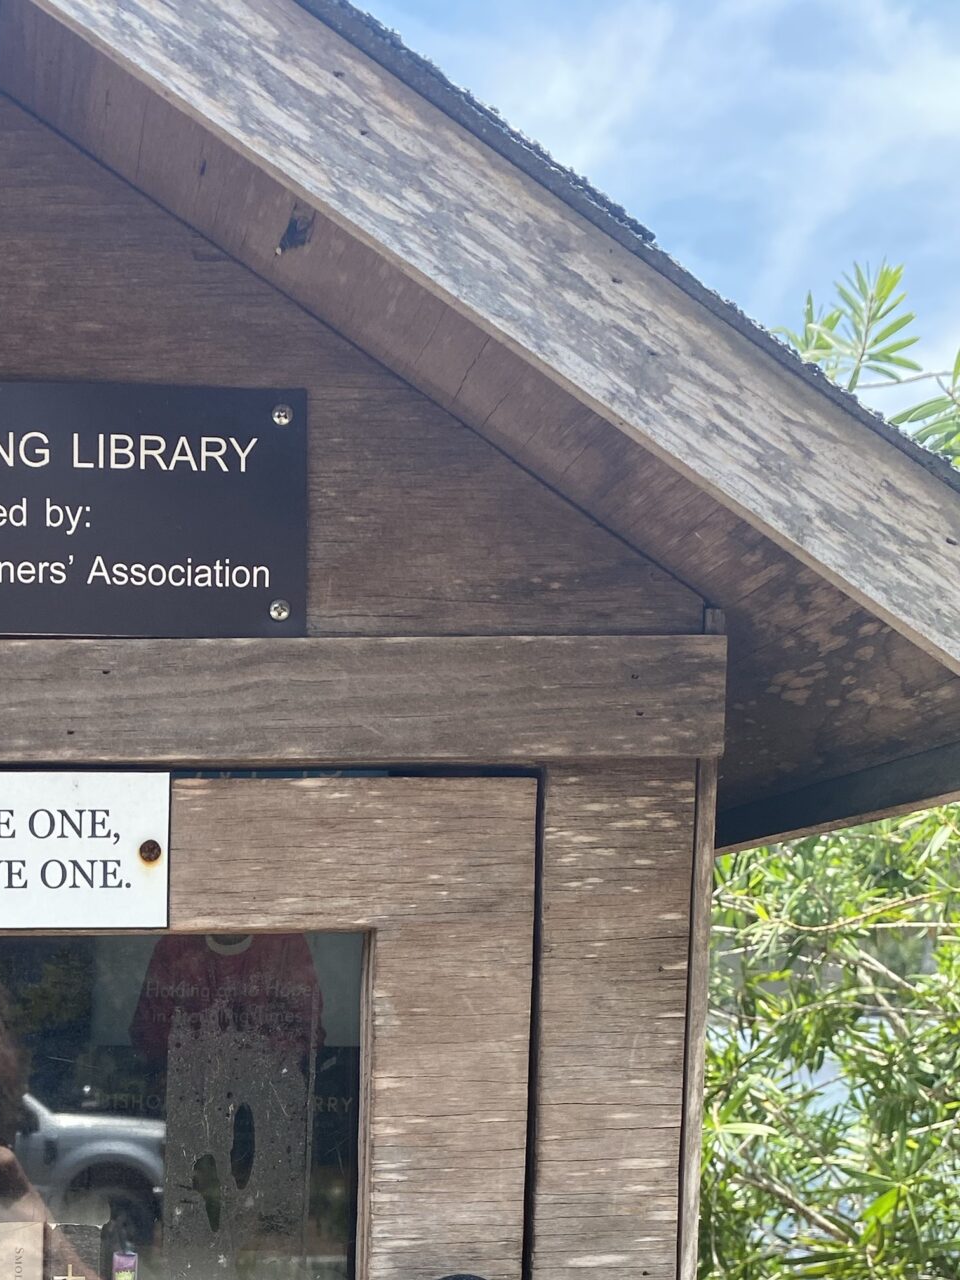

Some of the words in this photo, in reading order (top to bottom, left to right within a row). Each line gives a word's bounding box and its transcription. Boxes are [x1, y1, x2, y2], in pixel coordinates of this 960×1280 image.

[72, 433, 258, 472] LIBRARY
[45, 497, 92, 535] by:
[86, 555, 271, 588] Association
[28, 808, 121, 845] ONE,
[40, 859, 132, 889] ONE.
